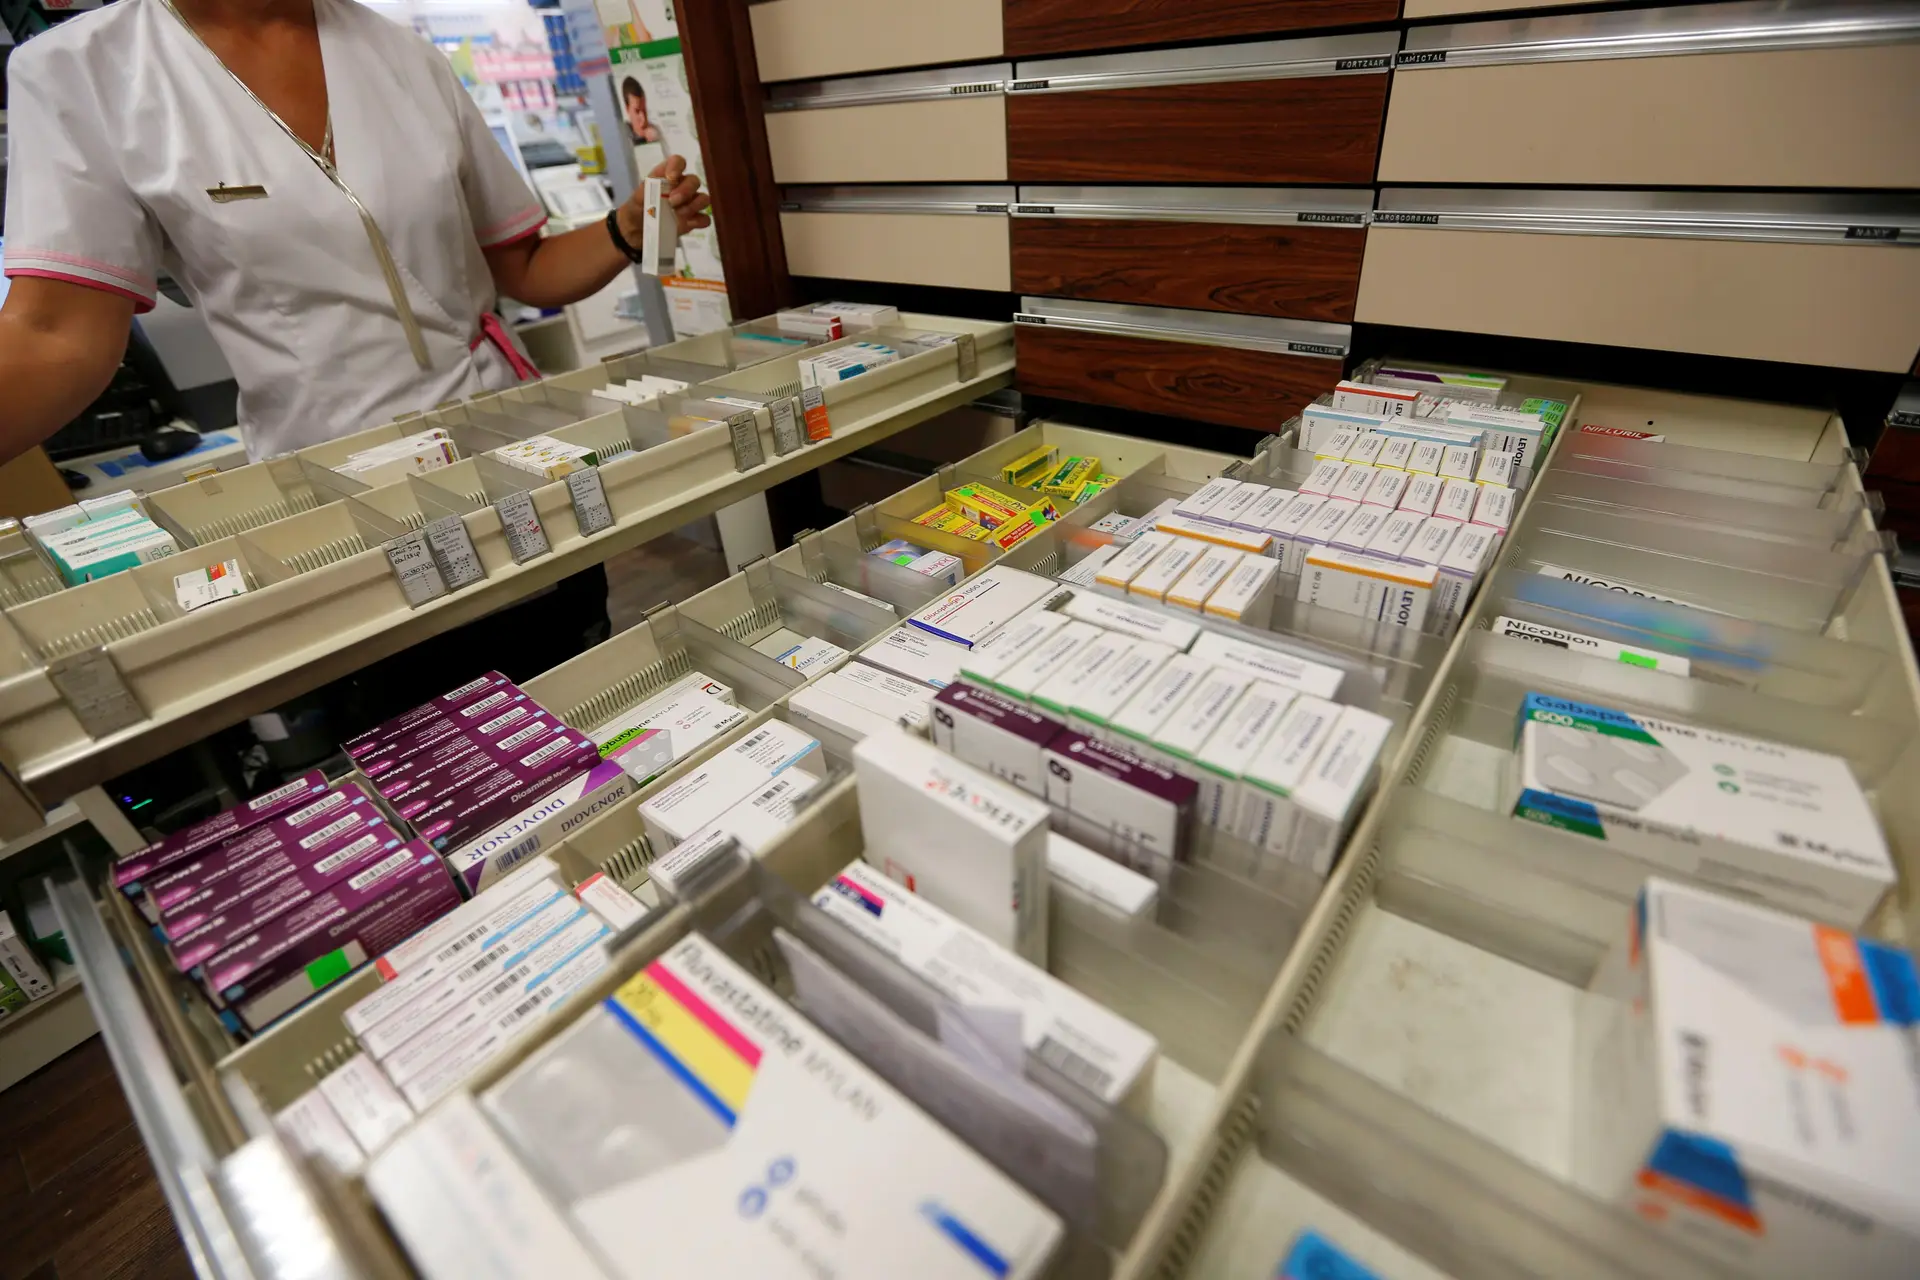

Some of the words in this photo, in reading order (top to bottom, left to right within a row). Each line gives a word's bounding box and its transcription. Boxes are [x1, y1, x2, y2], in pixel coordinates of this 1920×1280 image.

[1341, 59, 1384, 68] FORTZAAR
[1398, 54, 1443, 64] LAMICTAL
[1302, 213, 1355, 223] FURADANTINE
[1583, 424, 1647, 439] NIFLURIL
[1506, 620, 1599, 648] Nicobion
[400, 711, 442, 733] Diosmine
[598, 718, 652, 753] xybutynine
[651, 702, 679, 723] MYLAN
[720, 711, 742, 727] Mylan
[1532, 709, 1574, 729] 600
[1533, 696, 1698, 740] Gabapentine
[417, 728, 460, 751] Diosmine
[435, 746, 479, 770] Diosmine
[453, 764, 499, 788] Diosmine
[477, 781, 524, 807] Diosmine
[510, 776, 553, 804] Diosmine
[561, 786, 626, 833] DIOVENOR
[466, 798, 567, 861] DIOVENOR
